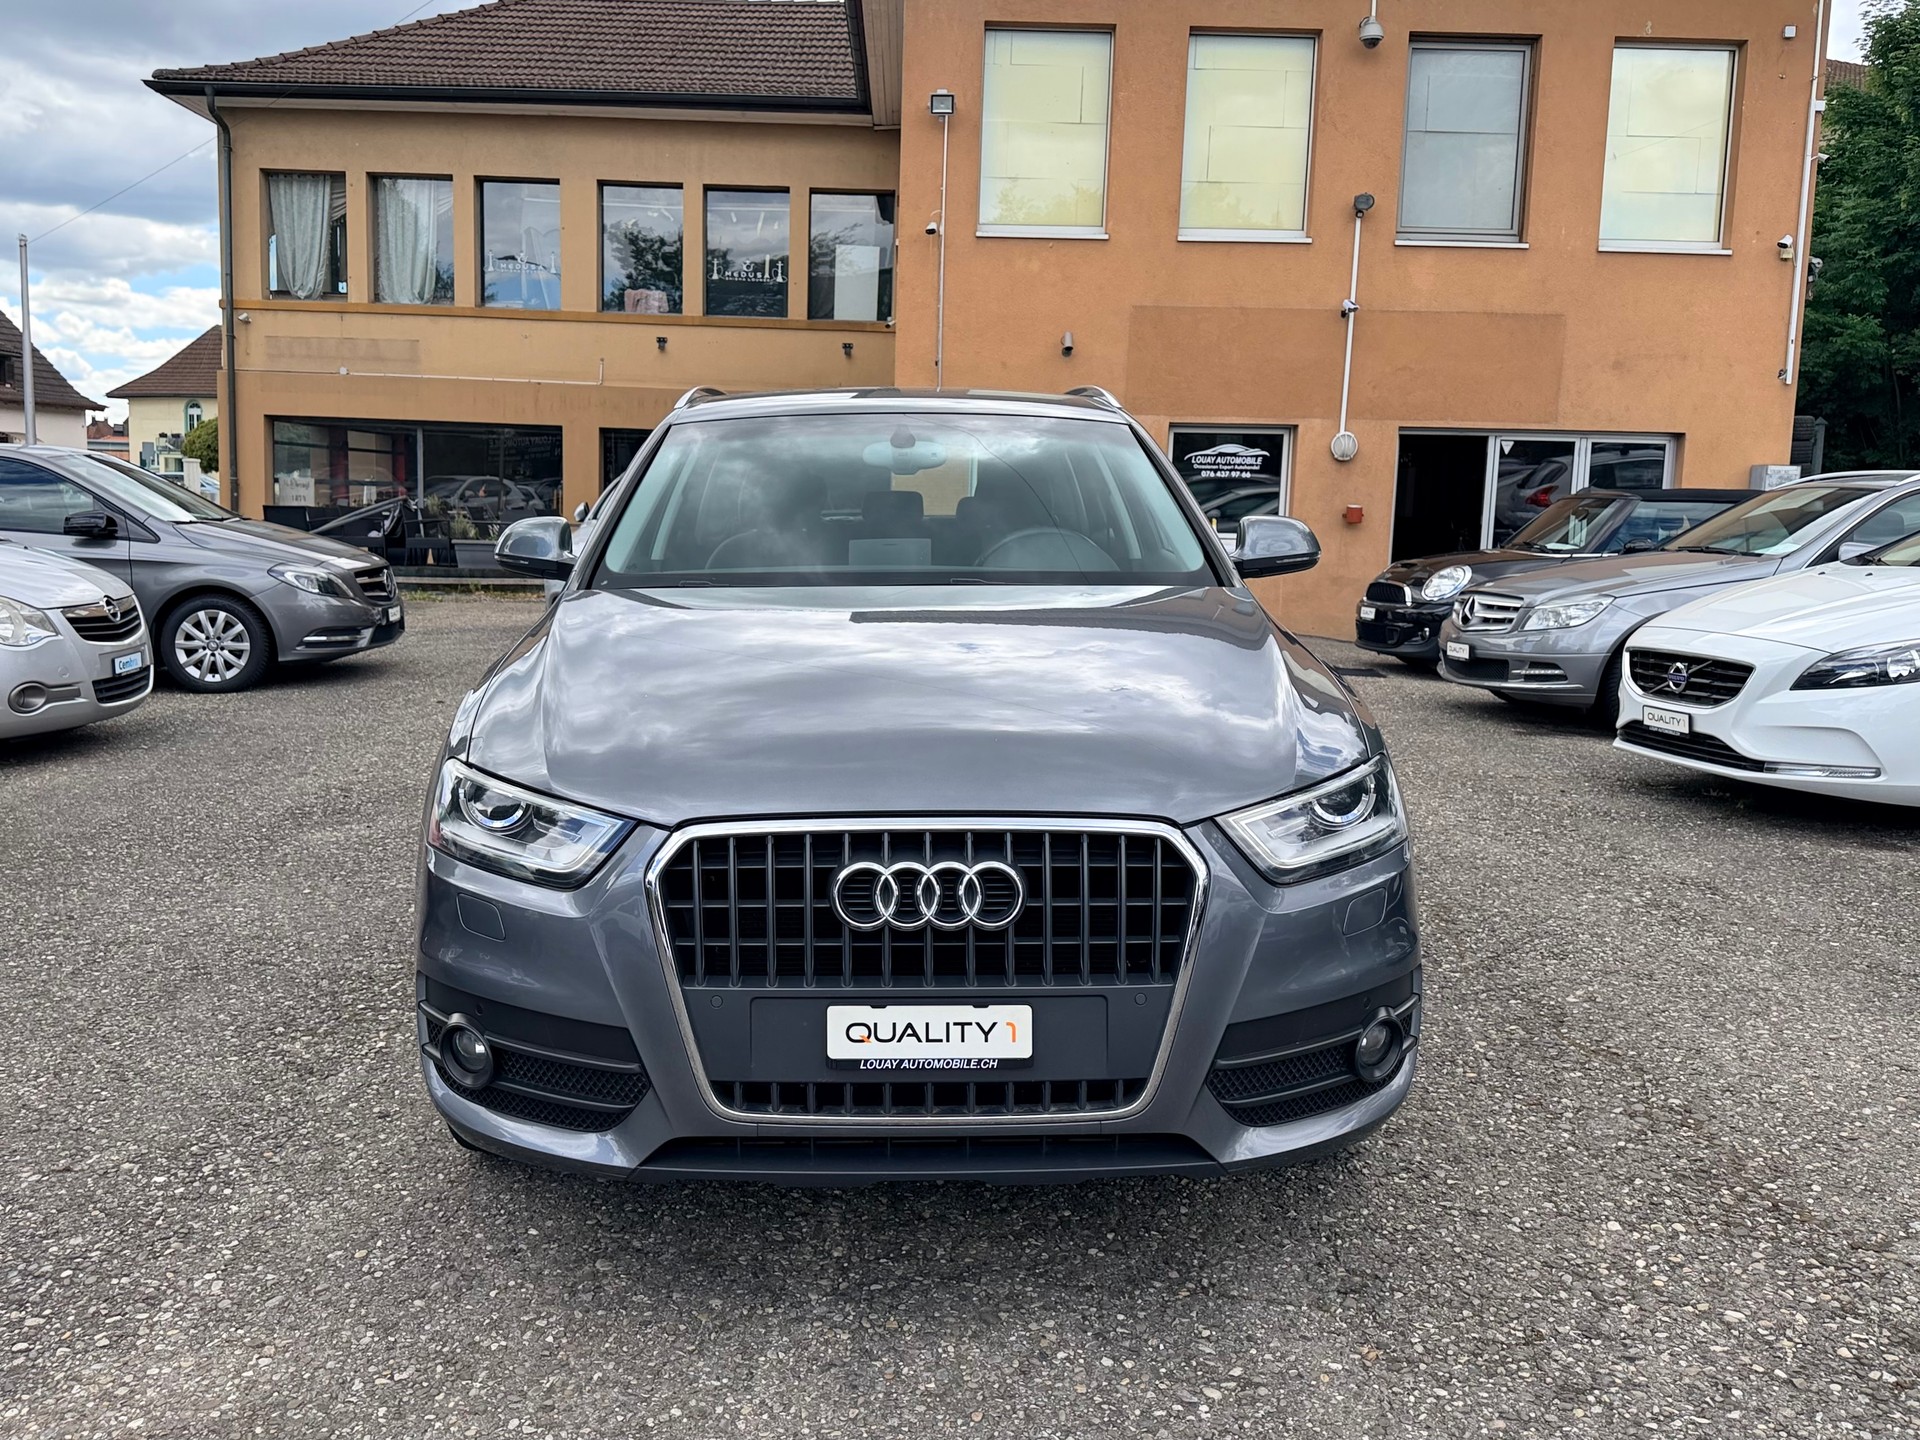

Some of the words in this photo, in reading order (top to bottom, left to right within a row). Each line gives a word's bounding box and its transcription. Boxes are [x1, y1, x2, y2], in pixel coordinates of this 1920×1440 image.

[1191, 456, 1216, 464] LOUAY
[1216, 456, 1263, 465] AUTOMOBILE
[1201, 470, 1215, 478] 076
[1216, 470, 1230, 478] 437
[1647, 712, 1681, 726] QUALITY
[846, 1021, 998, 1044] QUALITY
[1005, 1021, 1017, 1044] 1
[859, 1058, 901, 1070] LOUAY
[900, 1058, 999, 1070] AUTOMOBILE.CH
